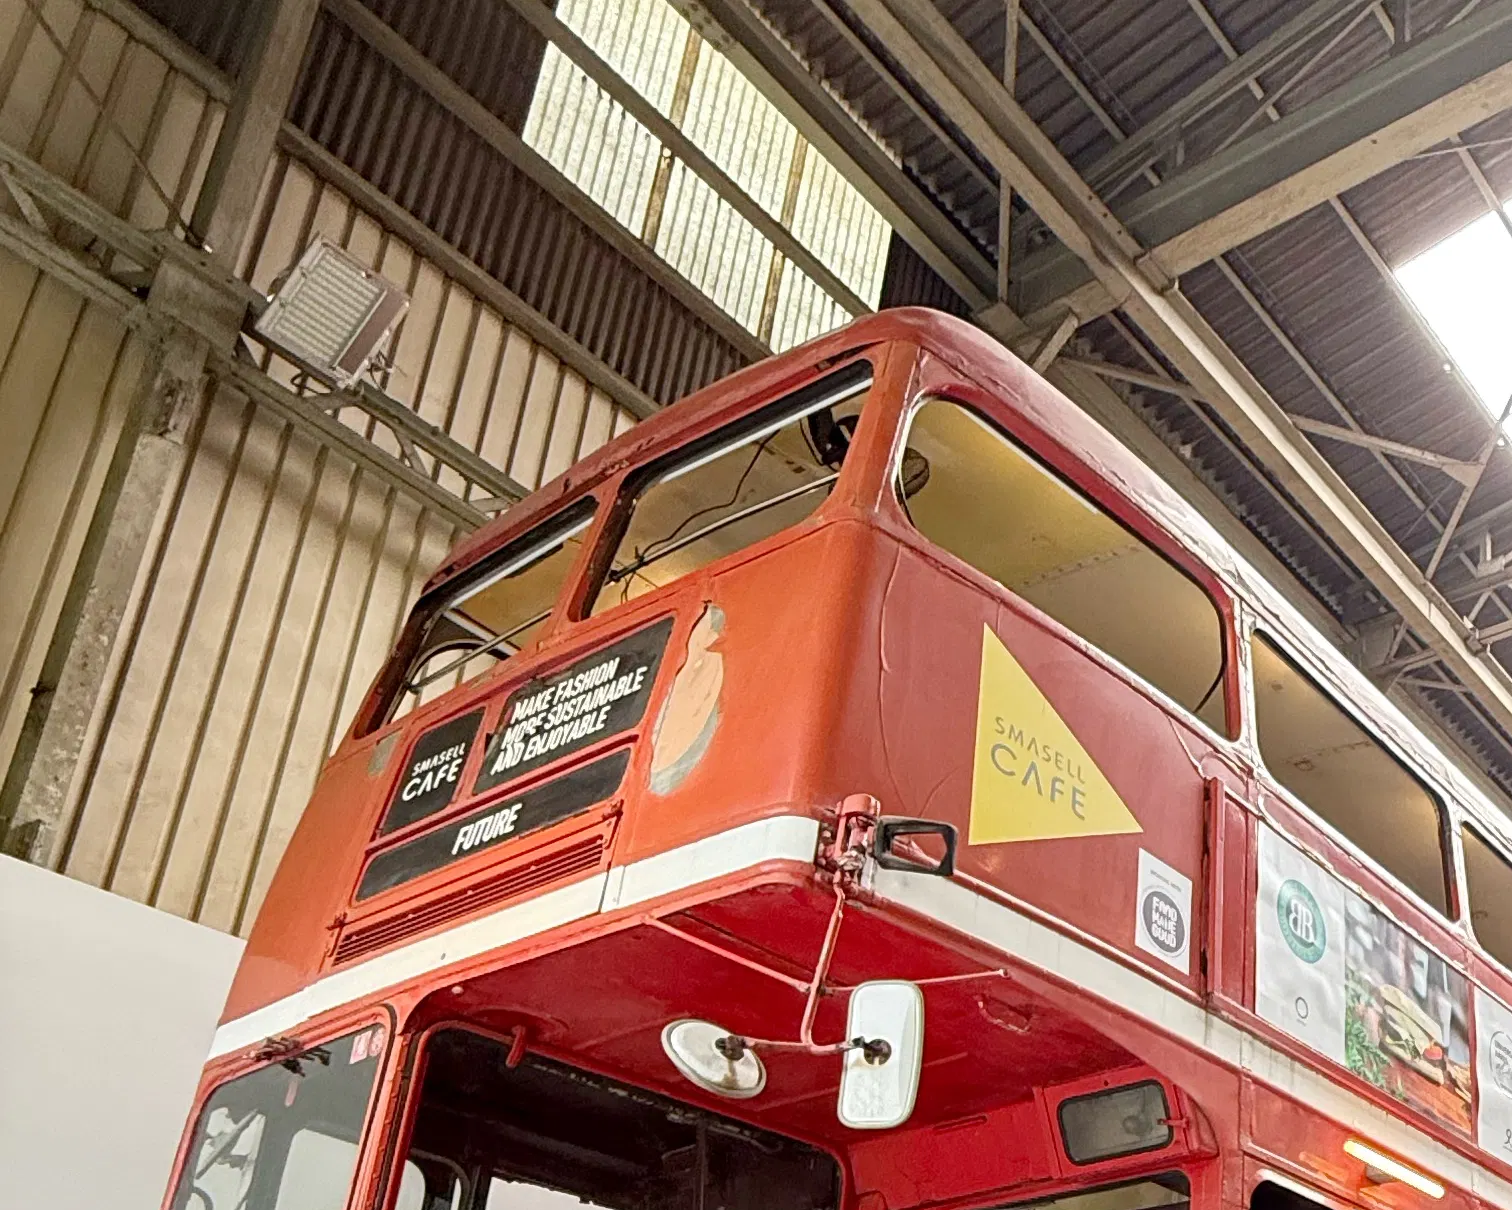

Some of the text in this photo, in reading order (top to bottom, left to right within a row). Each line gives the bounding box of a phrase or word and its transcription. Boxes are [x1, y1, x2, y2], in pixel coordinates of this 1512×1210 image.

[500, 666, 648, 750] MORE SUSTAINABLE
[510, 657, 620, 724] MAKE FASHION
[411, 743, 466, 777] SMASELL
[490, 705, 611, 776] AND ENJOYABLE
[994, 716, 1085, 785] SMASELL
[401, 758, 463, 801] CAFE
[990, 743, 1086, 821] CAFE
[451, 803, 523, 856] FUTURE
